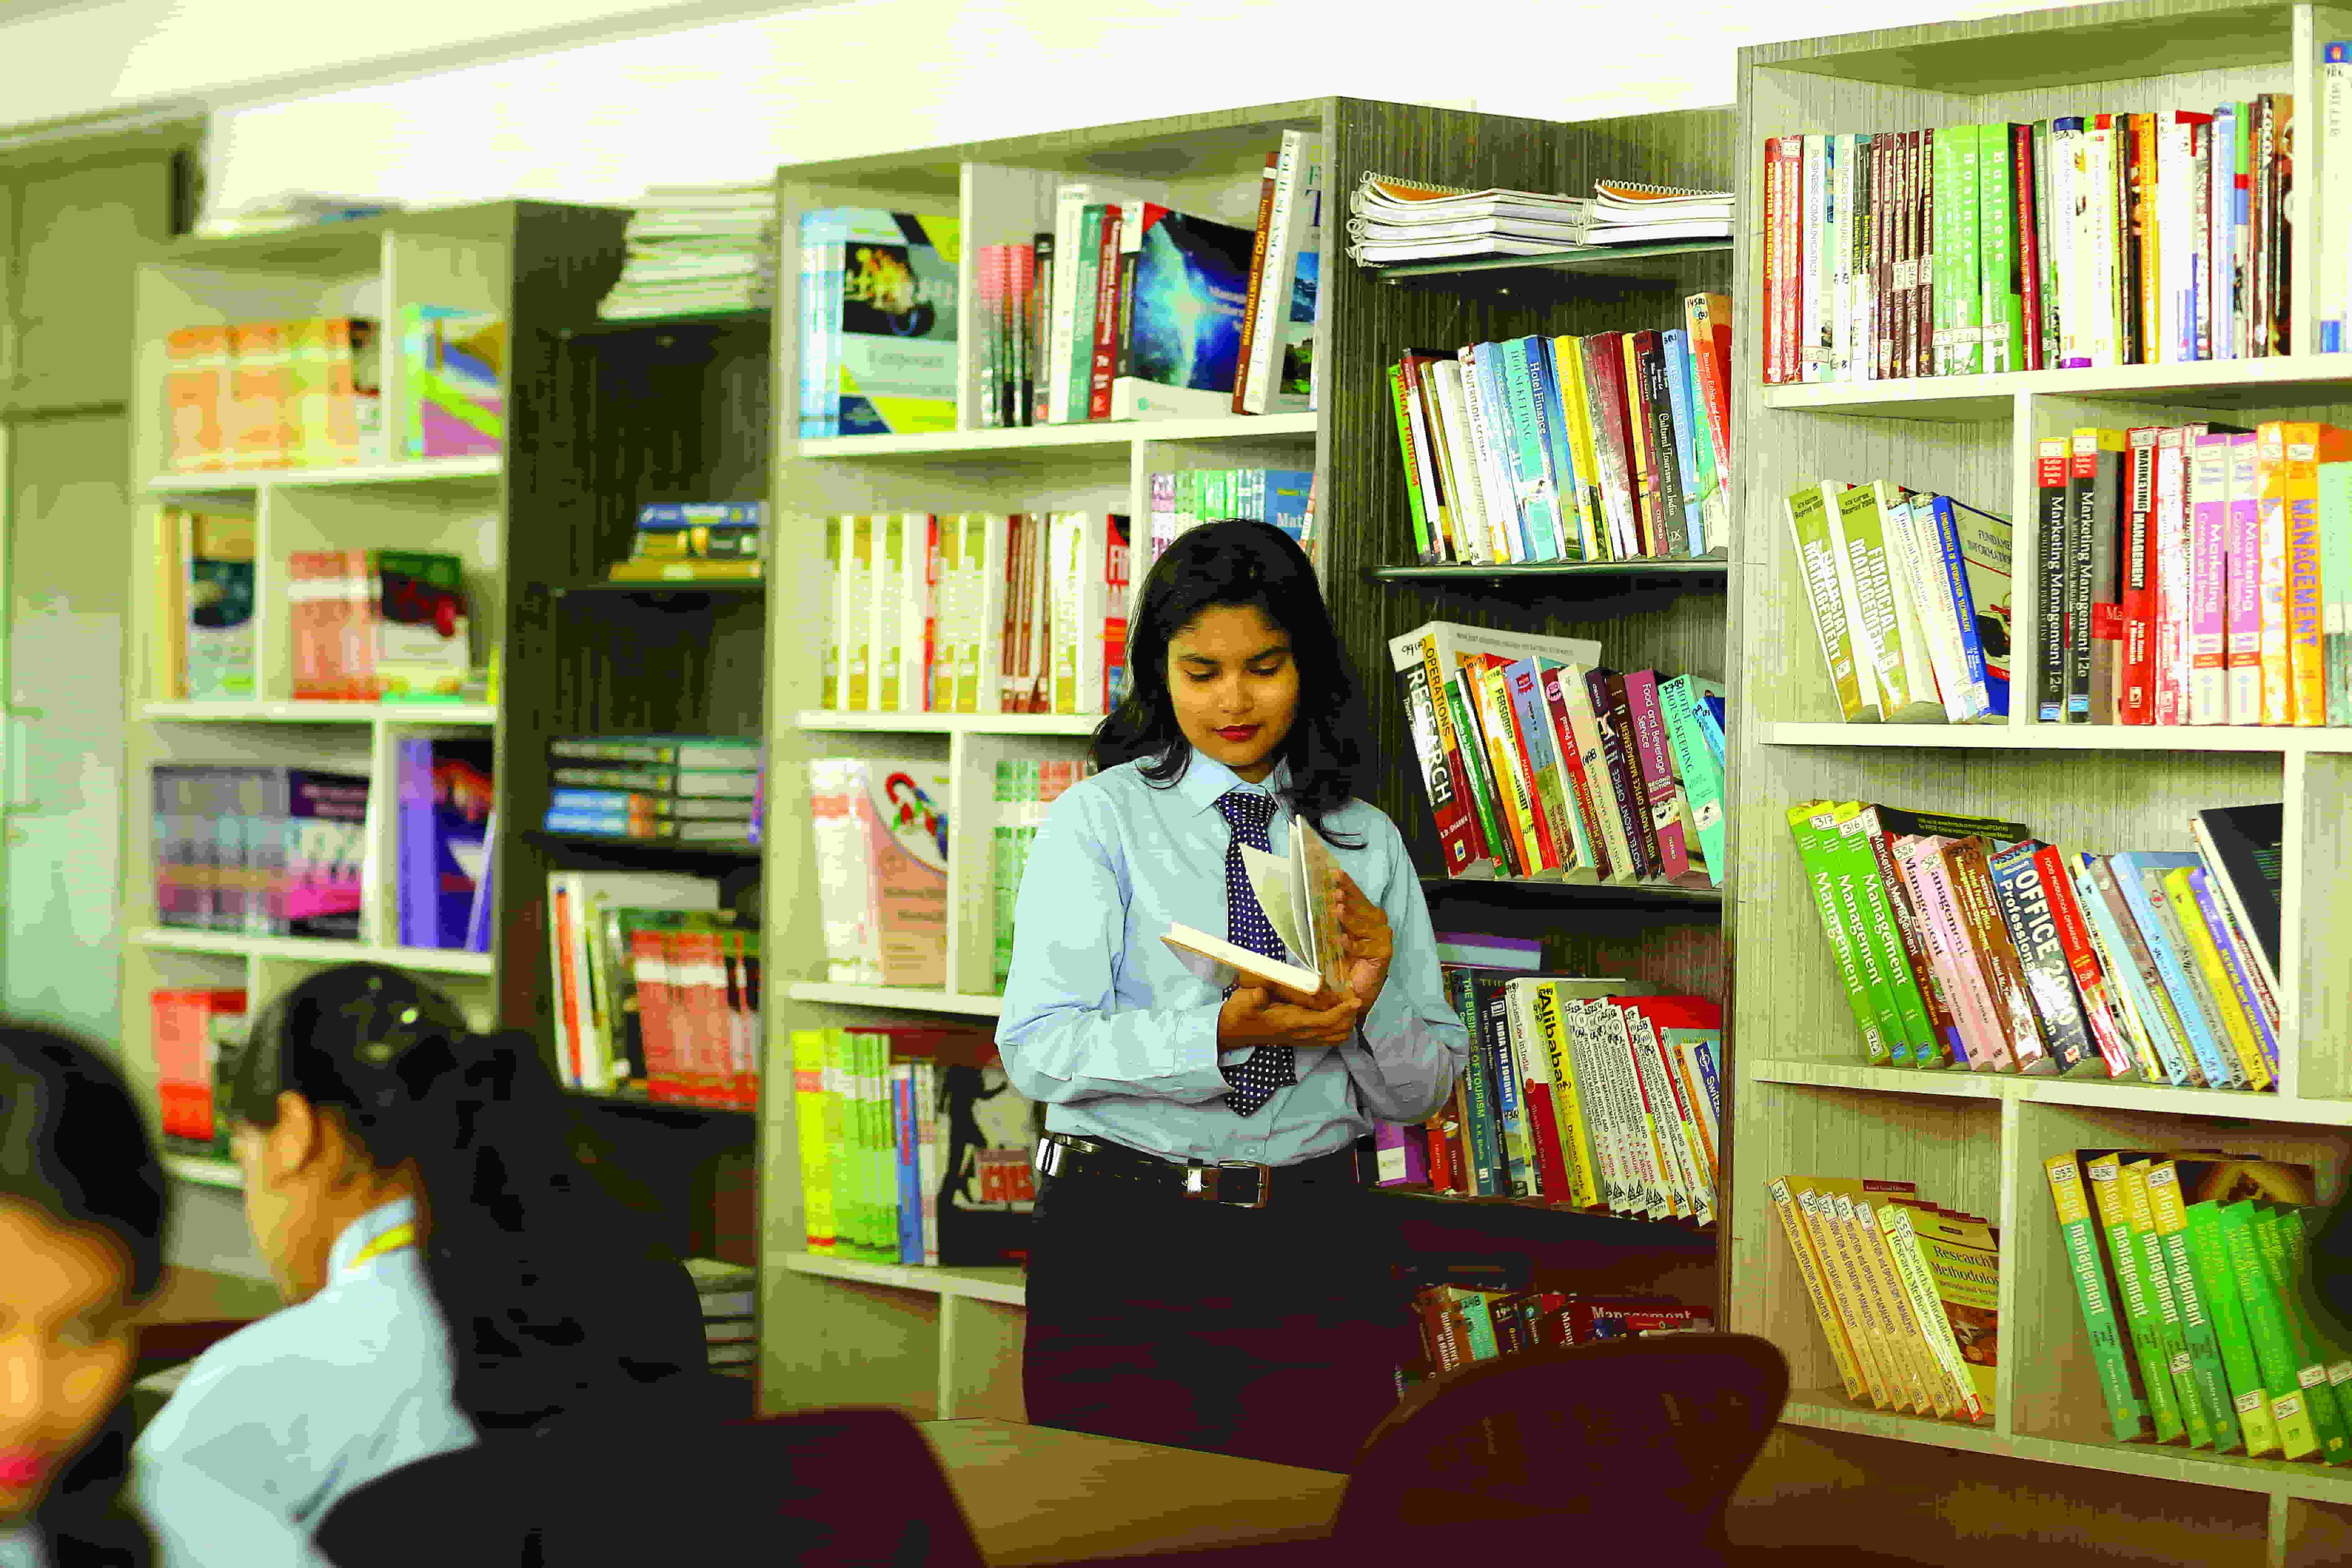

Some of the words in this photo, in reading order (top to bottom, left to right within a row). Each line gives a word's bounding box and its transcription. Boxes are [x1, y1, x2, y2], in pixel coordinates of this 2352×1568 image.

[1510, 350, 1532, 441] HOUSEKEEPING
[1530, 362, 1543, 391] Hotel
[1533, 391, 1548, 434] Finance
[1659, 413, 1672, 447] Cultural
[1662, 447, 1676, 487] Tourism
[2137, 449, 2149, 510] MARKETING
[1667, 496, 1676, 517] India
[2047, 496, 2065, 570] Marketing
[2077, 490, 2095, 561] Marketing
[2132, 512, 2145, 589] MANAGEMENT
[2291, 499, 2317, 648] MANAGEMENT
[1804, 539, 1841, 661] MANAGEMENT
[2047, 573, 2064, 666] Management
[2076, 564, 2093, 652] Management
[1425, 648, 1450, 737] OPERATIONS
[1642, 683, 1654, 708] Food
[1647, 709, 1658, 728] and
[1619, 722, 1639, 776] MANAGEMENT
[1636, 714, 1650, 748] Service
[1651, 726, 1665, 774] Beverage
[1666, 692, 1694, 774] HOUSEKEEPING
[1613, 768, 1625, 802] OFFICE
[1632, 775, 1644, 806] OFFICE
[1619, 803, 1634, 834] FRONT
[1638, 806, 1650, 832] FRONT
[1644, 832, 1655, 859] HOTEL
[1628, 835, 1643, 872] HOTEL
[1875, 834, 1895, 884] Marketing
[1891, 885, 1919, 957] Management
[1905, 857, 1944, 958] Management
[1931, 870, 1967, 956] anagement
[1999, 880, 2036, 972] Professiona
[2015, 868, 2060, 961] OFFICE
[1815, 871, 1866, 994] Management
[1838, 874, 1884, 987] Management
[1861, 873, 1908, 987] Management
[1463, 979, 1474, 997] THE
[1466, 999, 1480, 1052] BUSINESS
[1496, 1020, 1508, 1047] INDIA
[1516, 1023, 1524, 1039] Law
[1539, 994, 1564, 1083] Alibaba
[1473, 1054, 1481, 1068] OF
[1474, 1069, 1486, 1118] TOURISM
[1568, 1124, 1579, 1162] Duncan
[1575, 1163, 1586, 1190] Clark
[1933, 1245, 1993, 1270] Research
[2070, 1222, 2107, 1315] management
[2112, 1225, 2150, 1319] management
[2142, 1233, 2180, 1326] management
[2167, 1233, 2206, 1329] management
